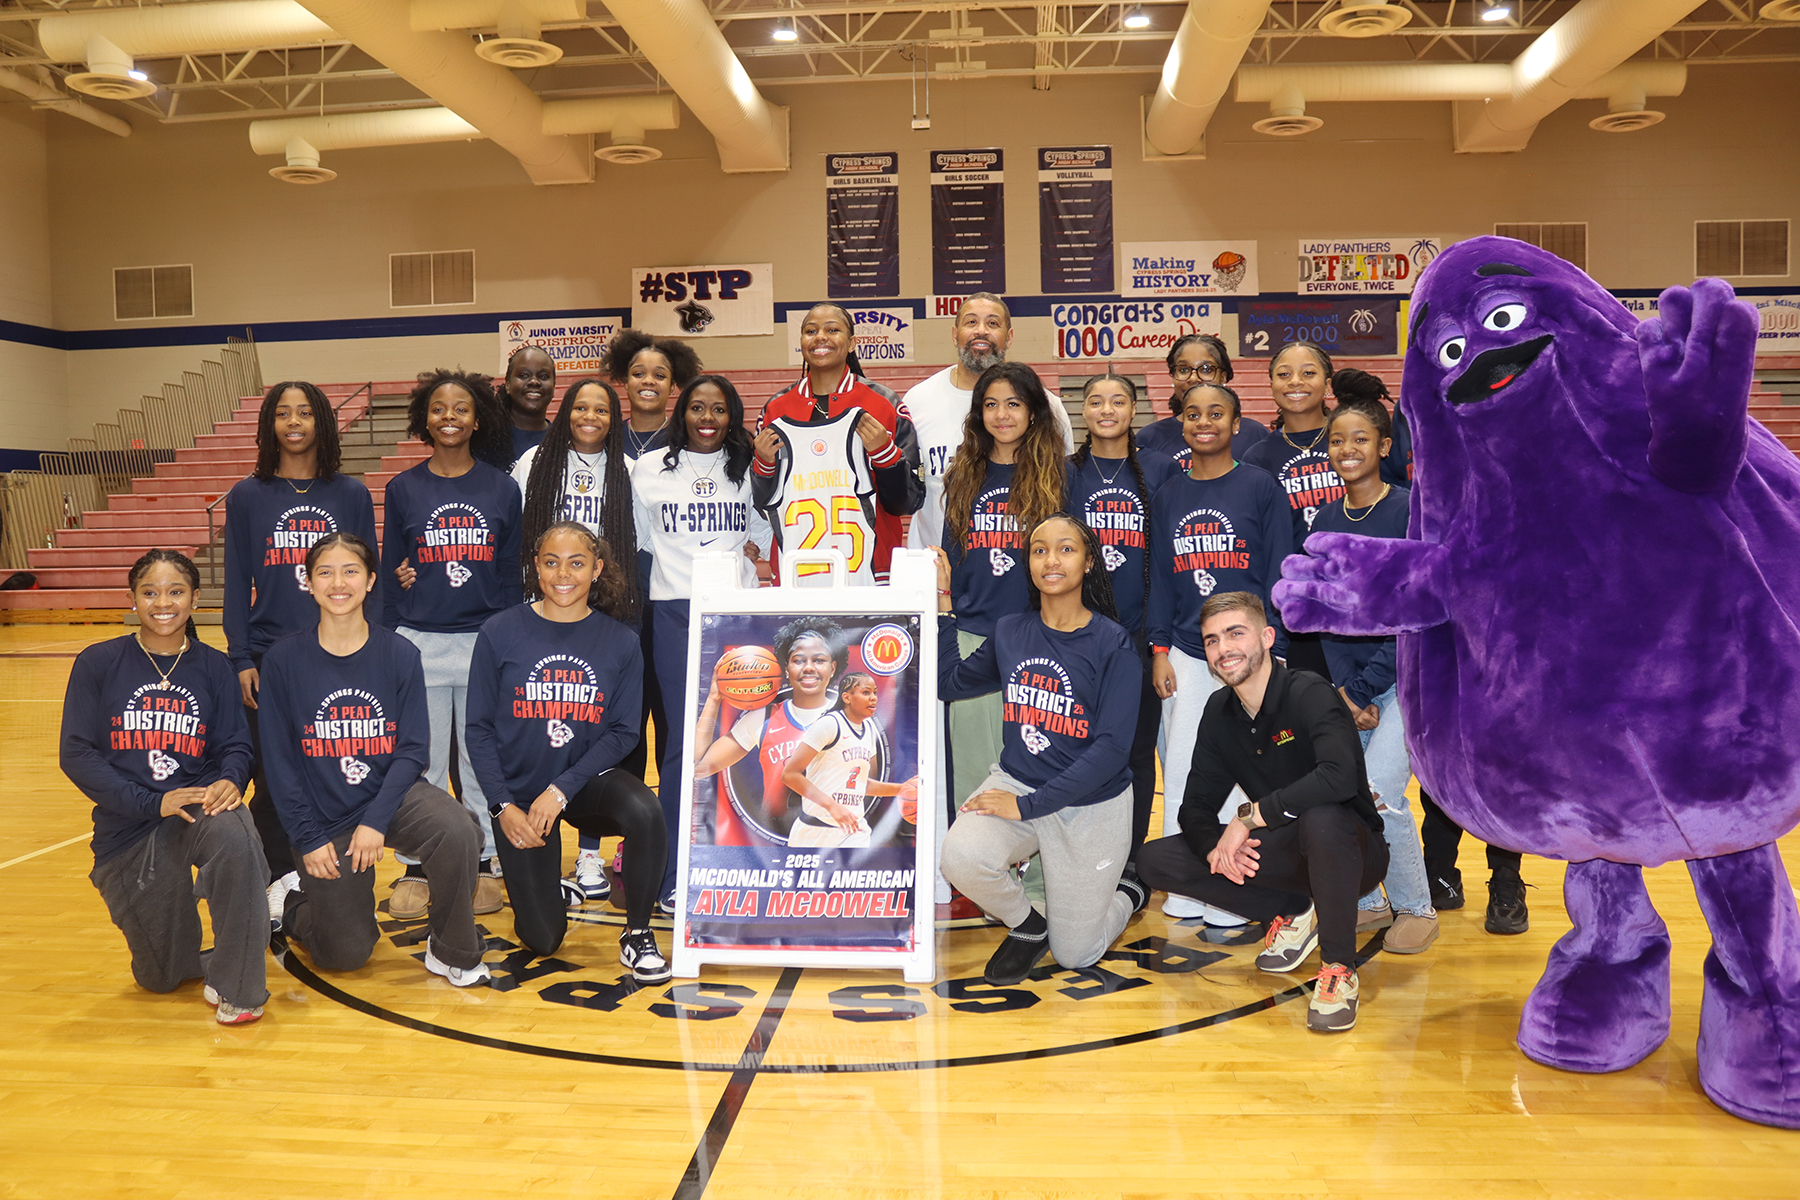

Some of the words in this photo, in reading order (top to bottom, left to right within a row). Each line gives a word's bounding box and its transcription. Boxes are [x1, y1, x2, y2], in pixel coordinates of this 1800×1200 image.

[1304, 244, 1332, 254] LADY
[1334, 242, 1391, 253] PANTHERS
[1133, 257, 1195, 272] Making
[1298, 254, 1410, 282] DEFEATED
[640, 269, 752, 302] #STP
[1133, 274, 1211, 288] HISTORY
[1307, 282, 1361, 292] EVERYONE,
[1364, 281, 1395, 290] TWICE
[936, 297, 967, 316] HO
[1171, 304, 1195, 318] on
[1198, 304, 1209, 317] a
[850, 311, 909, 332] RSITY
[1248, 314, 1275, 326] Ayla
[1278, 314, 1339, 324] McDowell
[529, 328, 566, 337] JUNIOR
[569, 325, 614, 335] VARSITY
[856, 336, 889, 344] STRICT
[1245, 330, 1270, 351] #2
[1283, 326, 1338, 342] 2000
[536, 336, 606, 346] DISTRICT
[1058, 326, 1114, 358] 1000
[1118, 325, 1178, 349] Career
[544, 345, 607, 359] AMPIONS
[858, 343, 905, 359] MPIONS
[1290, 467, 1298, 478] 3
[1301, 461, 1329, 475] PEAT
[1281, 471, 1345, 494] ISTRIC
[975, 487, 1009, 513] CY-SPRINGS
[986, 502, 994, 514] 3
[1085, 488, 1117, 511] CY-SPRINGS
[1119, 488, 1144, 514] PANTHERS
[1096, 500, 1104, 512] 3
[1106, 501, 1133, 513] PEAT
[276, 506, 310, 530] CY-SPRINGS
[289, 519, 296, 531] 3
[300, 519, 326, 532] PEAT
[426, 503, 458, 529] CY-SPRINGS
[460, 503, 487, 527] PANTHERS
[438, 517, 446, 528] 3
[449, 516, 475, 527] PEAT
[662, 502, 746, 532] CY-SPRINGS
[1175, 508, 1206, 537] CY-SPRINGS
[1207, 509, 1234, 533] PANTHERS
[424, 528, 489, 546] DISTRICT
[785, 495, 865, 577] 25
[1184, 524, 1192, 536] 3
[1194, 522, 1220, 535] PEAT
[274, 531, 330, 548] DISTR
[1173, 534, 1236, 555] DISTRICT
[1236, 539, 1246, 548] 25
[418, 544, 494, 563] CHAMPIONS
[871, 630, 904, 641] McDonald's
[528, 654, 566, 681] CY-SPRINGS
[568, 655, 596, 685] PANTHERS
[726, 659, 769, 674] Baden
[870, 658, 895, 670] American
[895, 650, 908, 668] Games
[542, 669, 551, 682] 3
[554, 669, 584, 683] PEAT
[1010, 658, 1049, 682] CY-SPRINGS
[1049, 660, 1072, 696] PANTHERS
[1020, 671, 1030, 685] 3
[1031, 673, 1060, 692] PEAT
[170, 685, 199, 715] PANTHERS
[515, 686, 525, 696] 24
[526, 682, 598, 704] DISTRICT
[595, 692, 604, 702] 25
[142, 696, 152, 710] 3
[156, 697, 187, 713] PEAT
[316, 688, 352, 720] CY-SPRINGS
[354, 689, 383, 717] PANTHERS
[329, 706, 338, 720] 3
[342, 706, 371, 719] PEAT
[513, 700, 604, 724] CHAMPIONS
[1073, 704, 1084, 715] 25
[111, 716, 122, 726] 24
[124, 710, 200, 736] DISTRICT
[197, 724, 207, 735] 25
[304, 725, 314, 734] 24
[314, 717, 386, 739] DISTRICT
[386, 721, 397, 731] 25
[110, 730, 206, 758] CHAMPIONS
[846, 766, 861, 789] 2
[785, 854, 820, 868] 2025
[689, 867, 794, 888] MCDONALD'S
[797, 870, 824, 888] ALL
[829, 869, 915, 889] AMERICAN
[692, 889, 758, 917] AYLA
[765, 890, 910, 918] MCDOWELL
